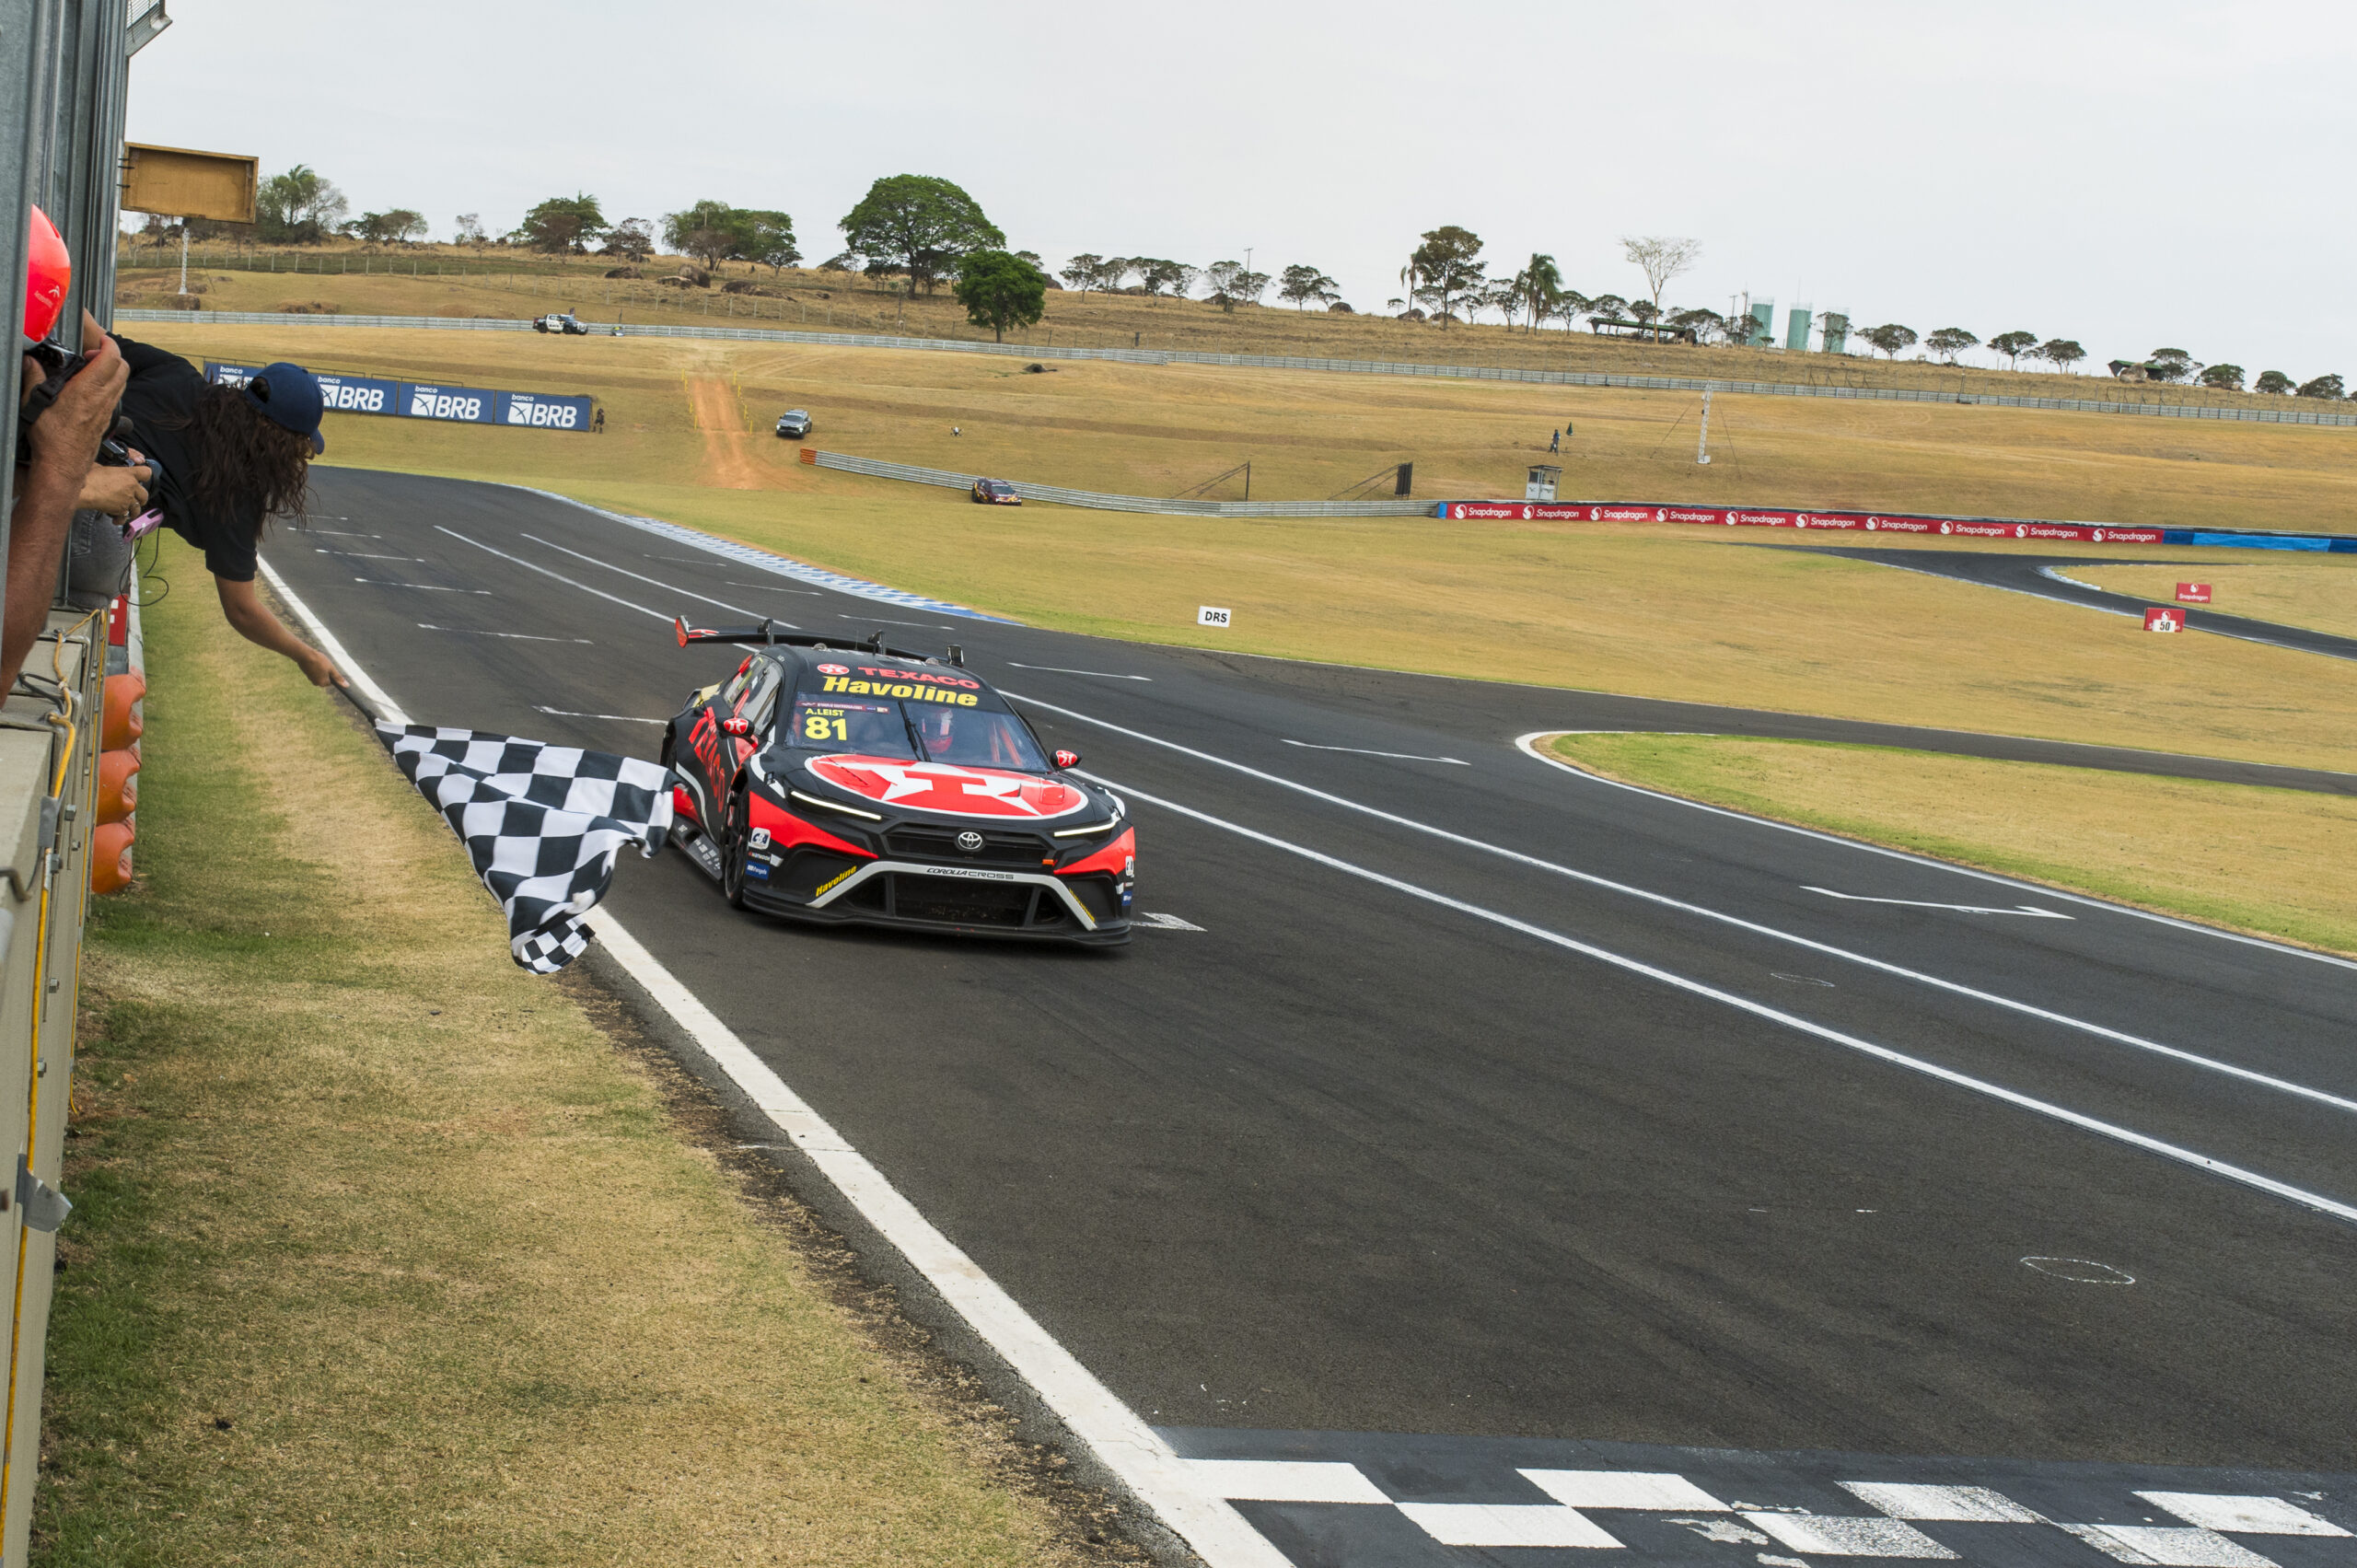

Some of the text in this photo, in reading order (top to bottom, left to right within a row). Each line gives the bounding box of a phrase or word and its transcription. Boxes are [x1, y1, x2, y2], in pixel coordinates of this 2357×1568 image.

[220, 366, 243, 375] banco
[318, 376, 341, 384] banco
[415, 386, 438, 394] banco
[338, 387, 385, 412] BRB
[511, 394, 534, 402] banco
[435, 395, 482, 420] BRB
[531, 403, 577, 428] BRB
[1469, 507, 1512, 518] Snapdragon
[1537, 509, 1580, 519] Snapdragon
[1604, 510, 1648, 521] Snapdragon
[1670, 511, 1715, 523] Snapdragon
[1740, 515, 1785, 526] Snapdragon
[1811, 517, 1855, 528] Snapdragon
[1881, 520, 1928, 531] Snapdragon
[1956, 525, 2005, 536] Snapdragon
[2030, 528, 2078, 539] Snapdragon
[2107, 531, 2156, 542] Snapdragon
[1204, 610, 1227, 623] DRS
[2159, 621, 2171, 631] 50
[858, 667, 981, 690] TEXACO
[822, 676, 978, 707] Havoline
[805, 708, 844, 716] A.LEIST
[805, 716, 847, 741] 81
[926, 867, 1015, 880] COROLLA CROSS
[815, 865, 857, 897] Havoline
